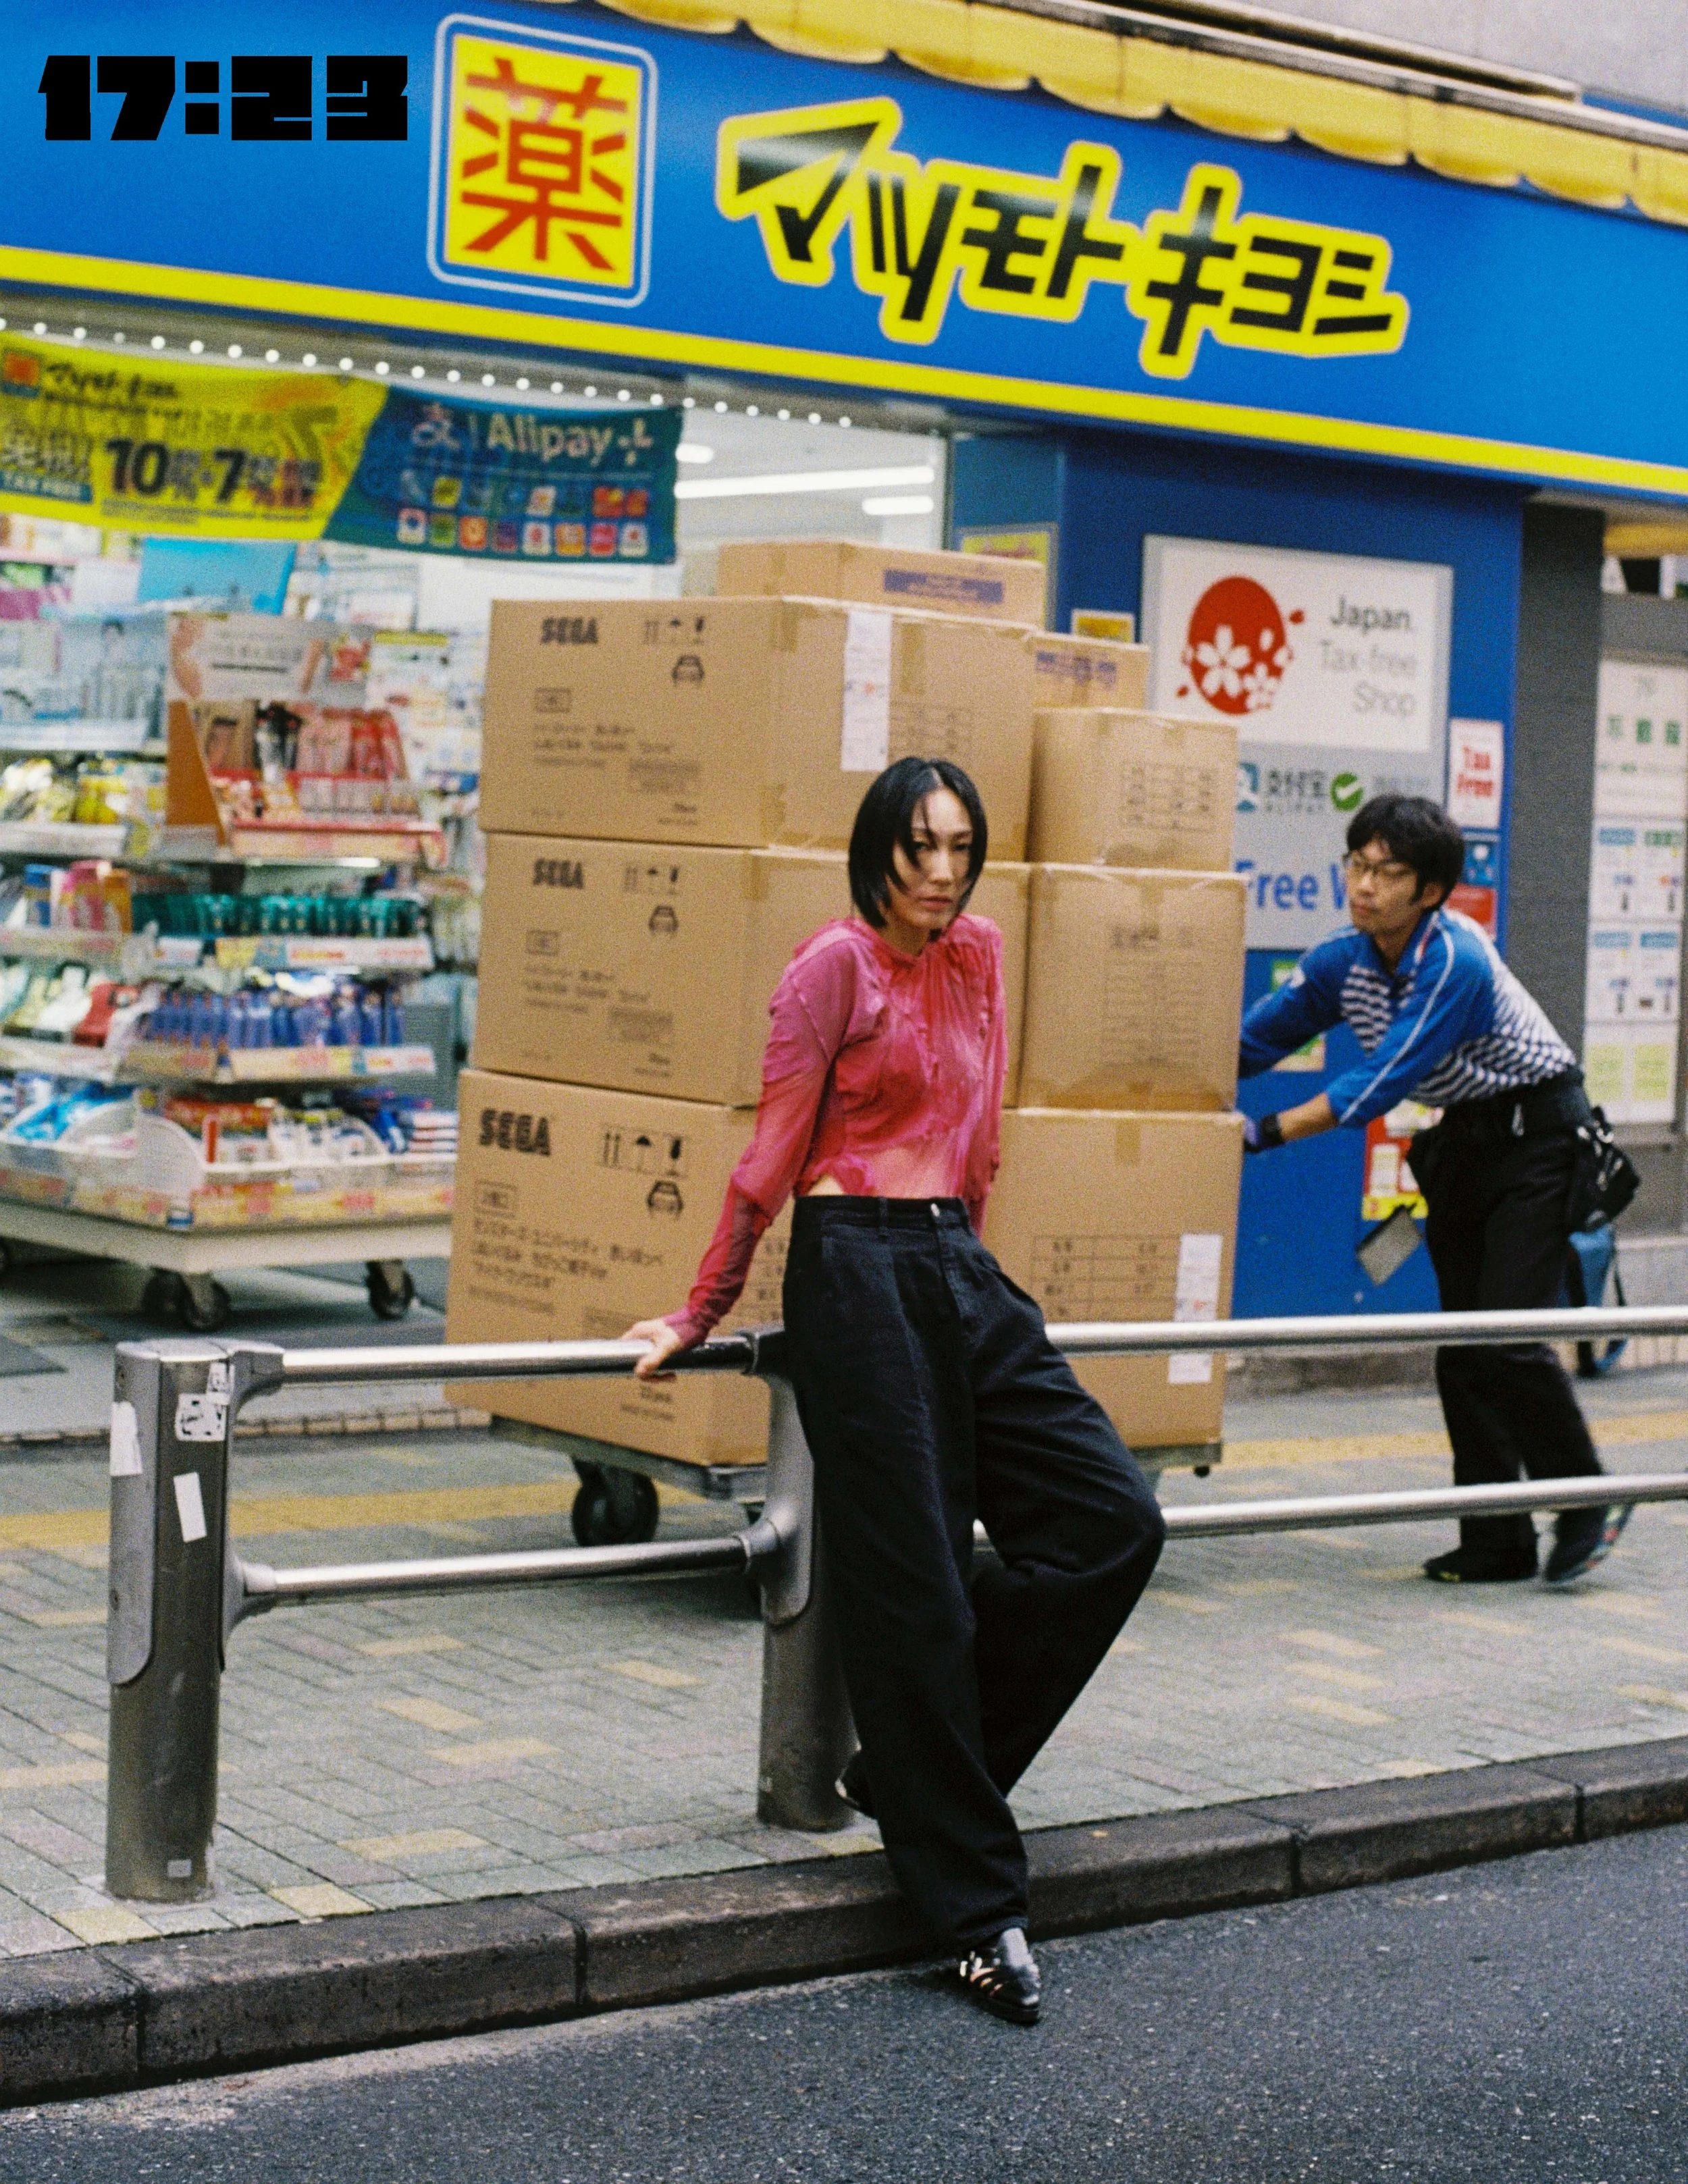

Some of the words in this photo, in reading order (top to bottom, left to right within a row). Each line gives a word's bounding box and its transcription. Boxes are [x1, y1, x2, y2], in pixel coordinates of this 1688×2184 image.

[460, 57, 628, 271] 薬
[733, 116, 1395, 358] マツモトキヨシ
[541, 616, 598, 645] SEGA
[1352, 680, 1417, 718] Shop
[532, 857, 584, 890] SEGA
[478, 1108, 552, 1157] SEGA
